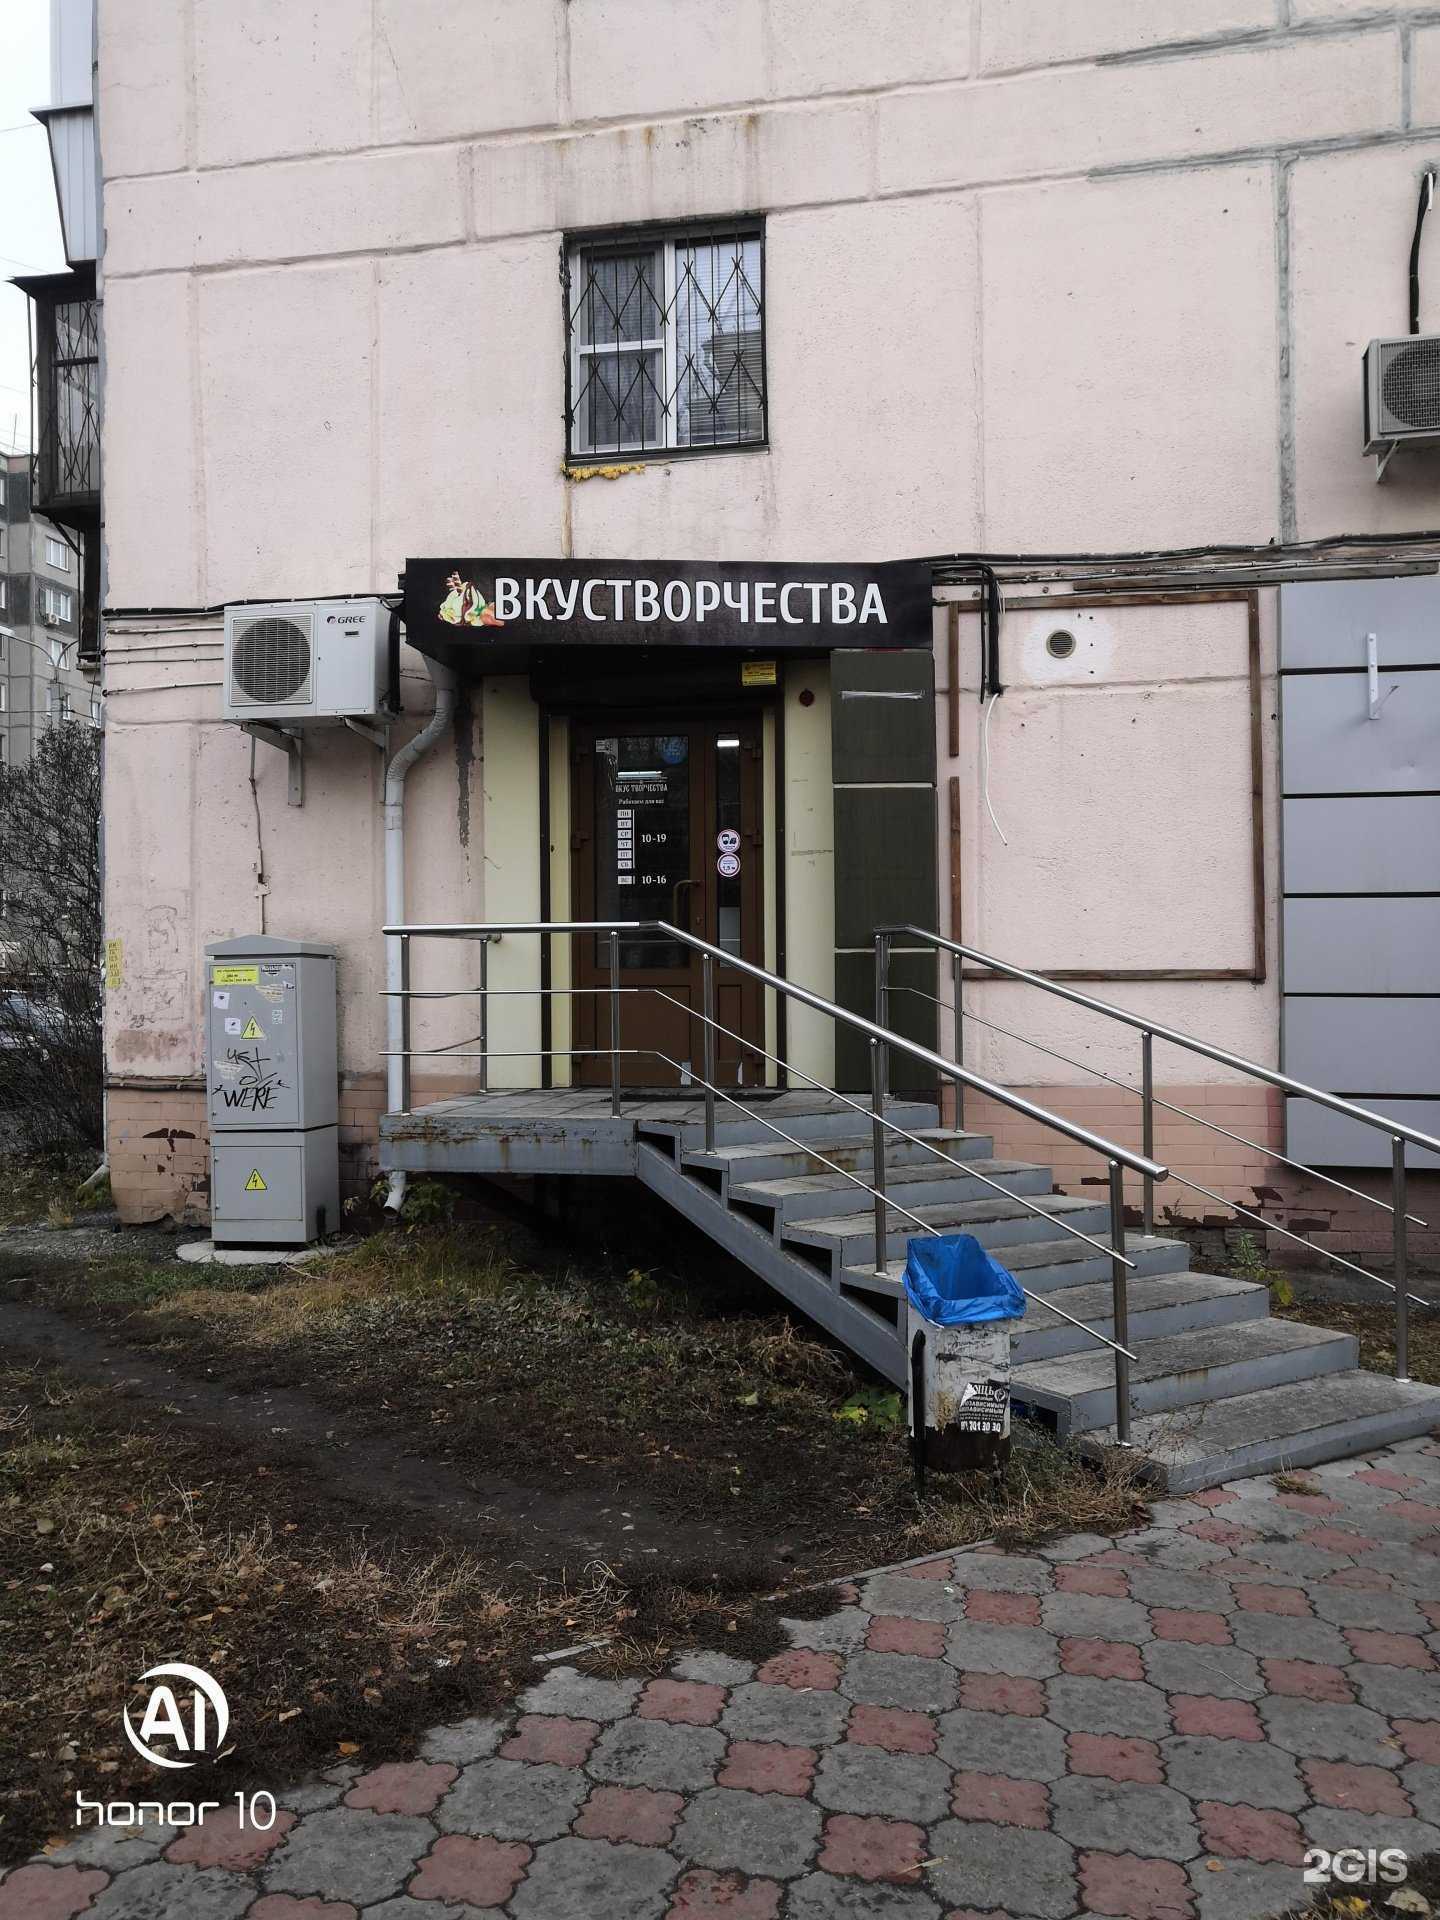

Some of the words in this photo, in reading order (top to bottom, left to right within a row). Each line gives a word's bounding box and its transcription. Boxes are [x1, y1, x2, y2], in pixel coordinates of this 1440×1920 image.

[337, 615, 367, 624] GREE
[631, 783, 668, 792] ТВОРЧЕСТВА
[641, 833, 667, 843] 10-19
[641, 875, 667, 885] 10-16
